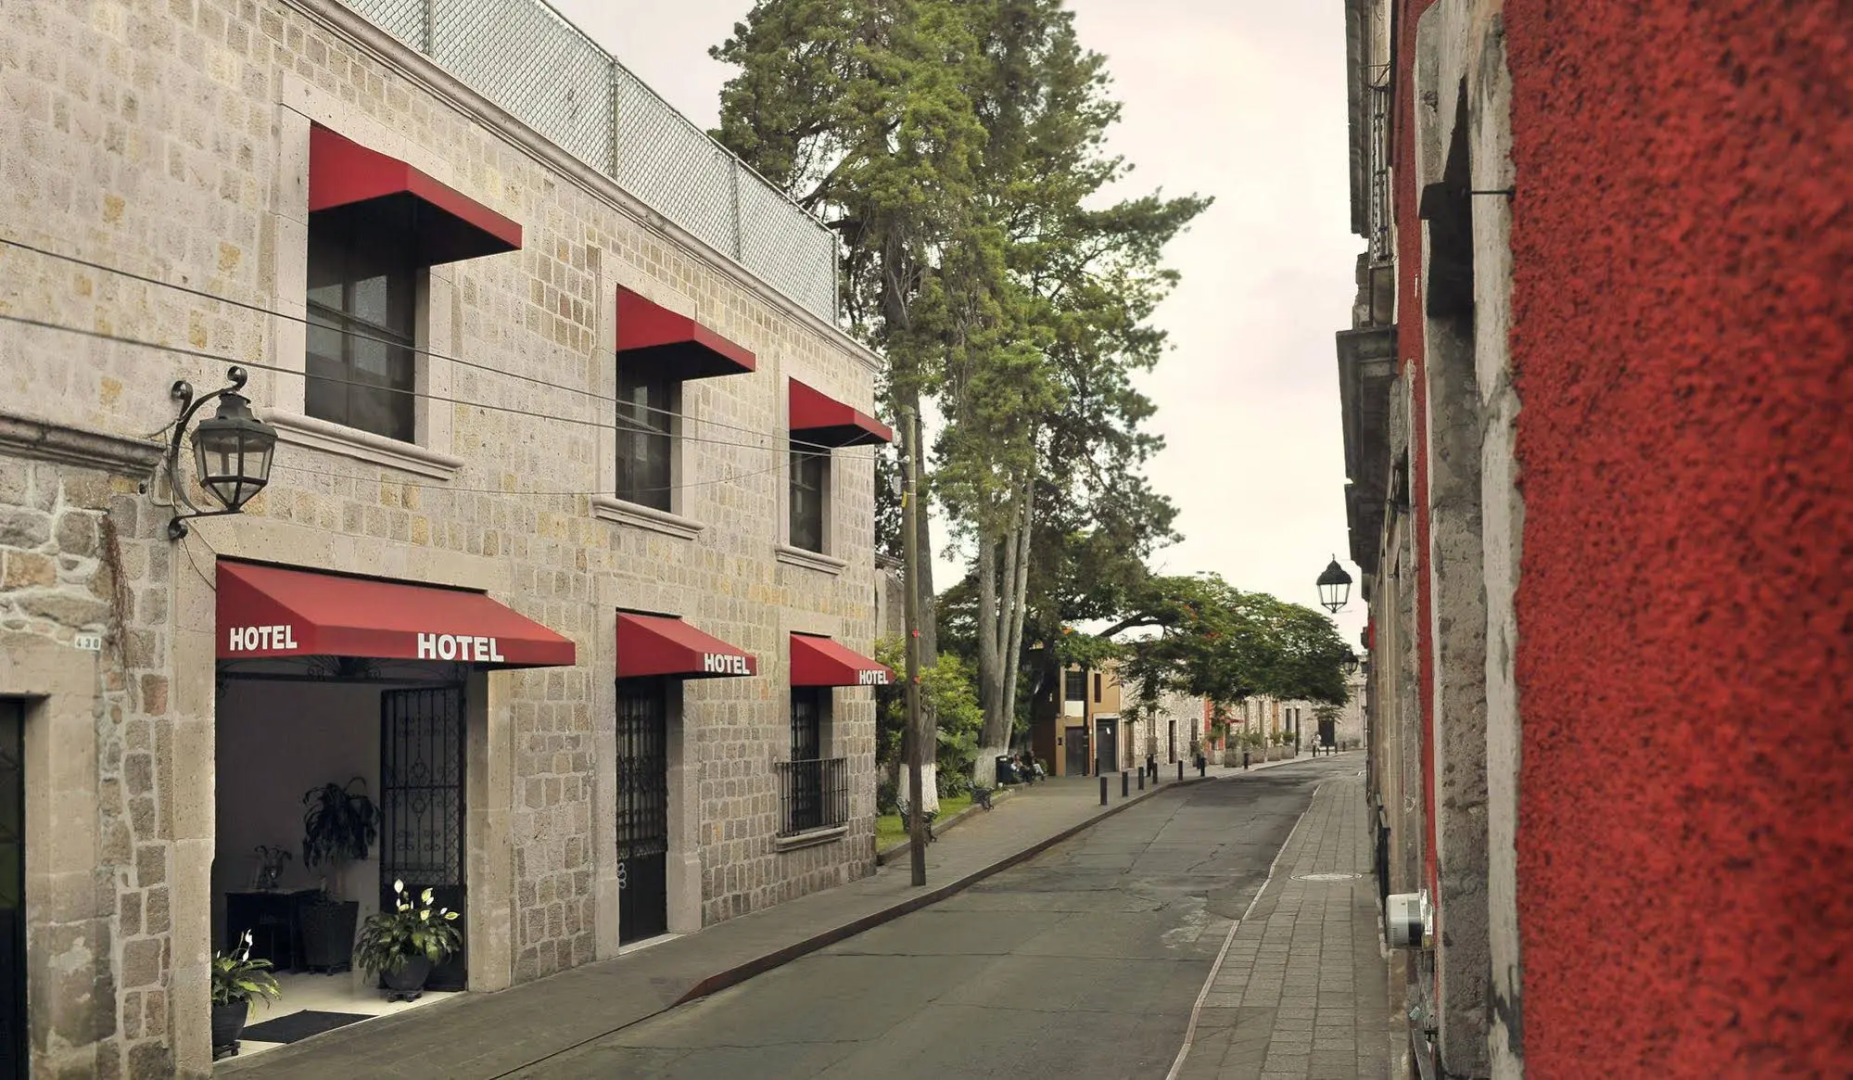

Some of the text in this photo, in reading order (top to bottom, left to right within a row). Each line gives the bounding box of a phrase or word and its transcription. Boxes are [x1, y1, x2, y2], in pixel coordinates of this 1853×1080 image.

[229, 625, 298, 651] HOTEL
[417, 632, 505, 662] HOTEL
[704, 653, 750, 675] HOTEL
[859, 670, 889, 685] HOTEL
